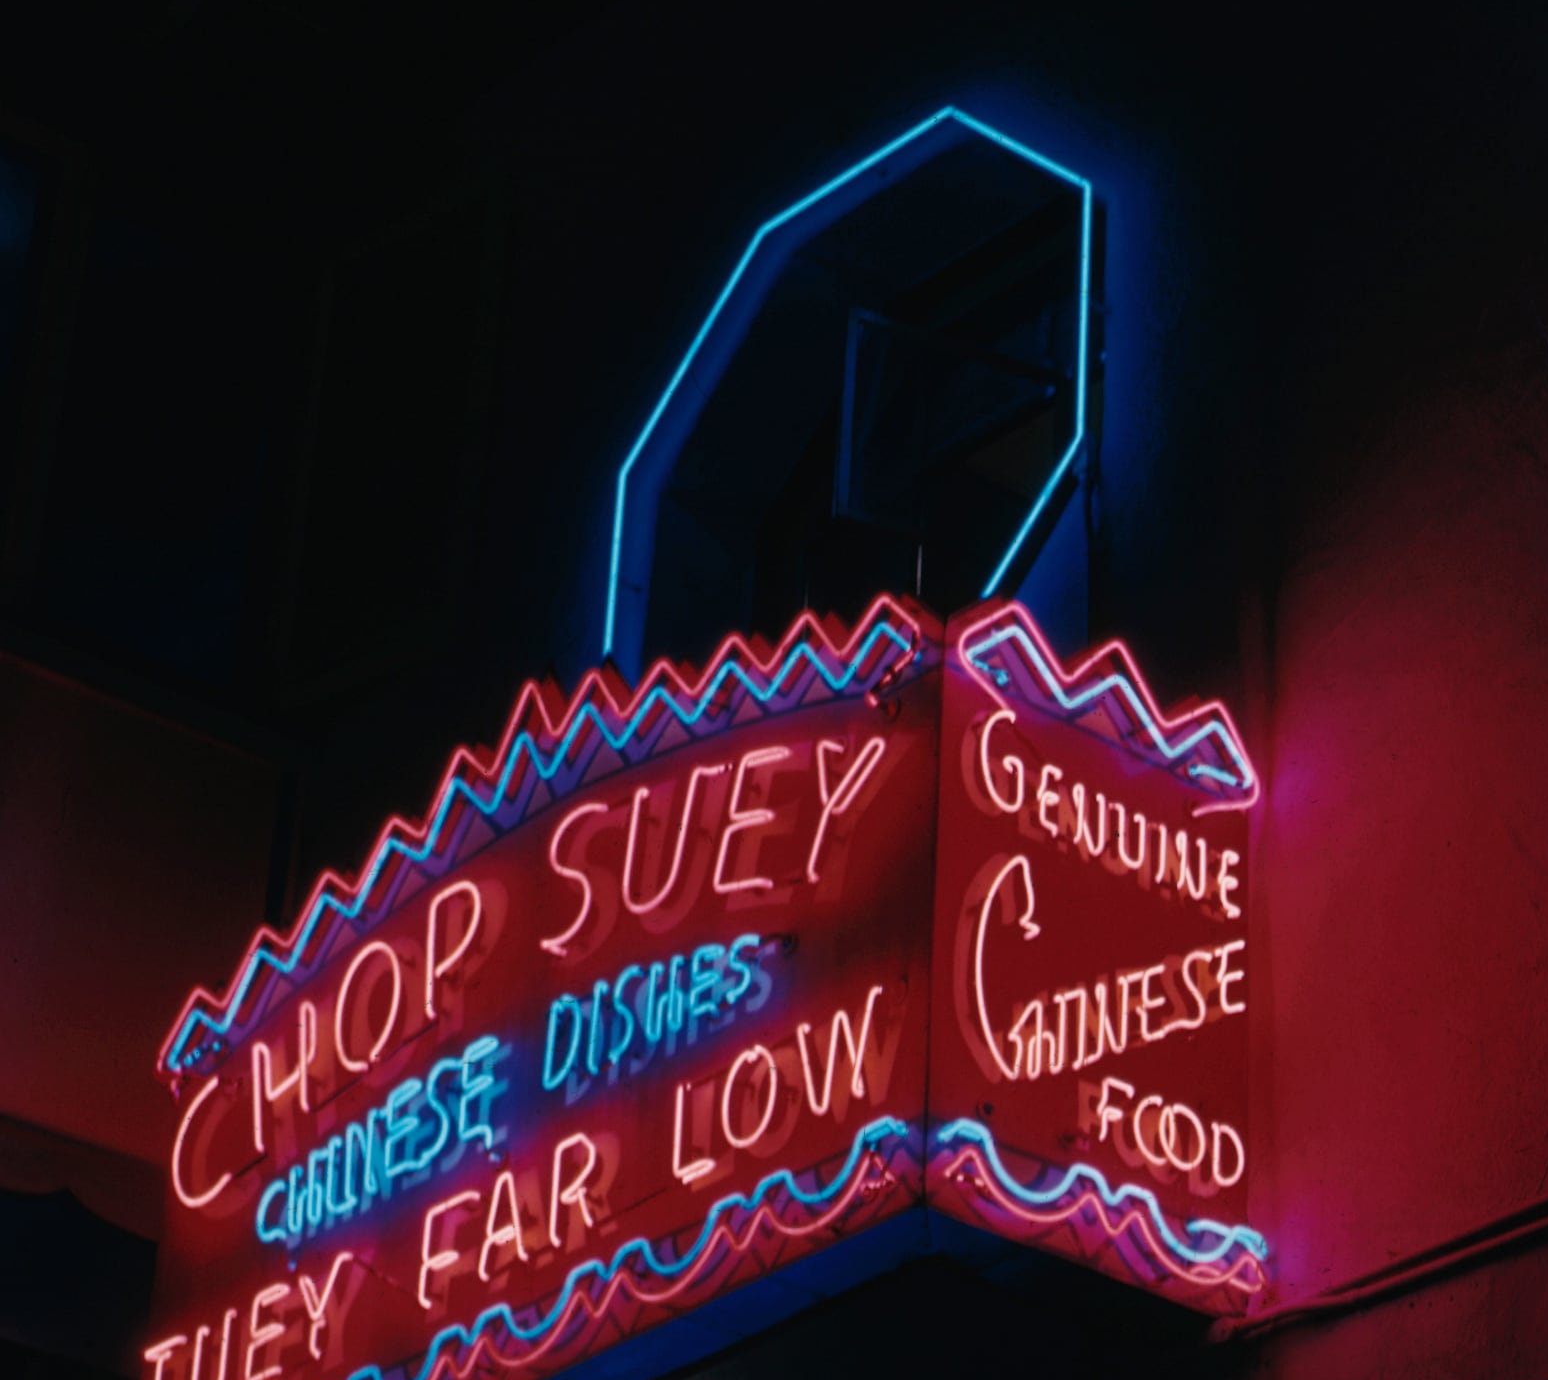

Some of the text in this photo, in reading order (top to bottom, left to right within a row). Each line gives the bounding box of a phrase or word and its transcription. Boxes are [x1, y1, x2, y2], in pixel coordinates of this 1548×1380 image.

[978, 711, 1243, 920] GENUINE
[171, 738, 886, 1208] CHOP SUEY
[256, 935, 762, 1244] CHINESE DISHES
[975, 856, 1246, 1080] CHINESE
[418, 1131, 597, 1310] FAR
[672, 987, 882, 1185] LOW
[1098, 1077, 1246, 1190] FOOD
